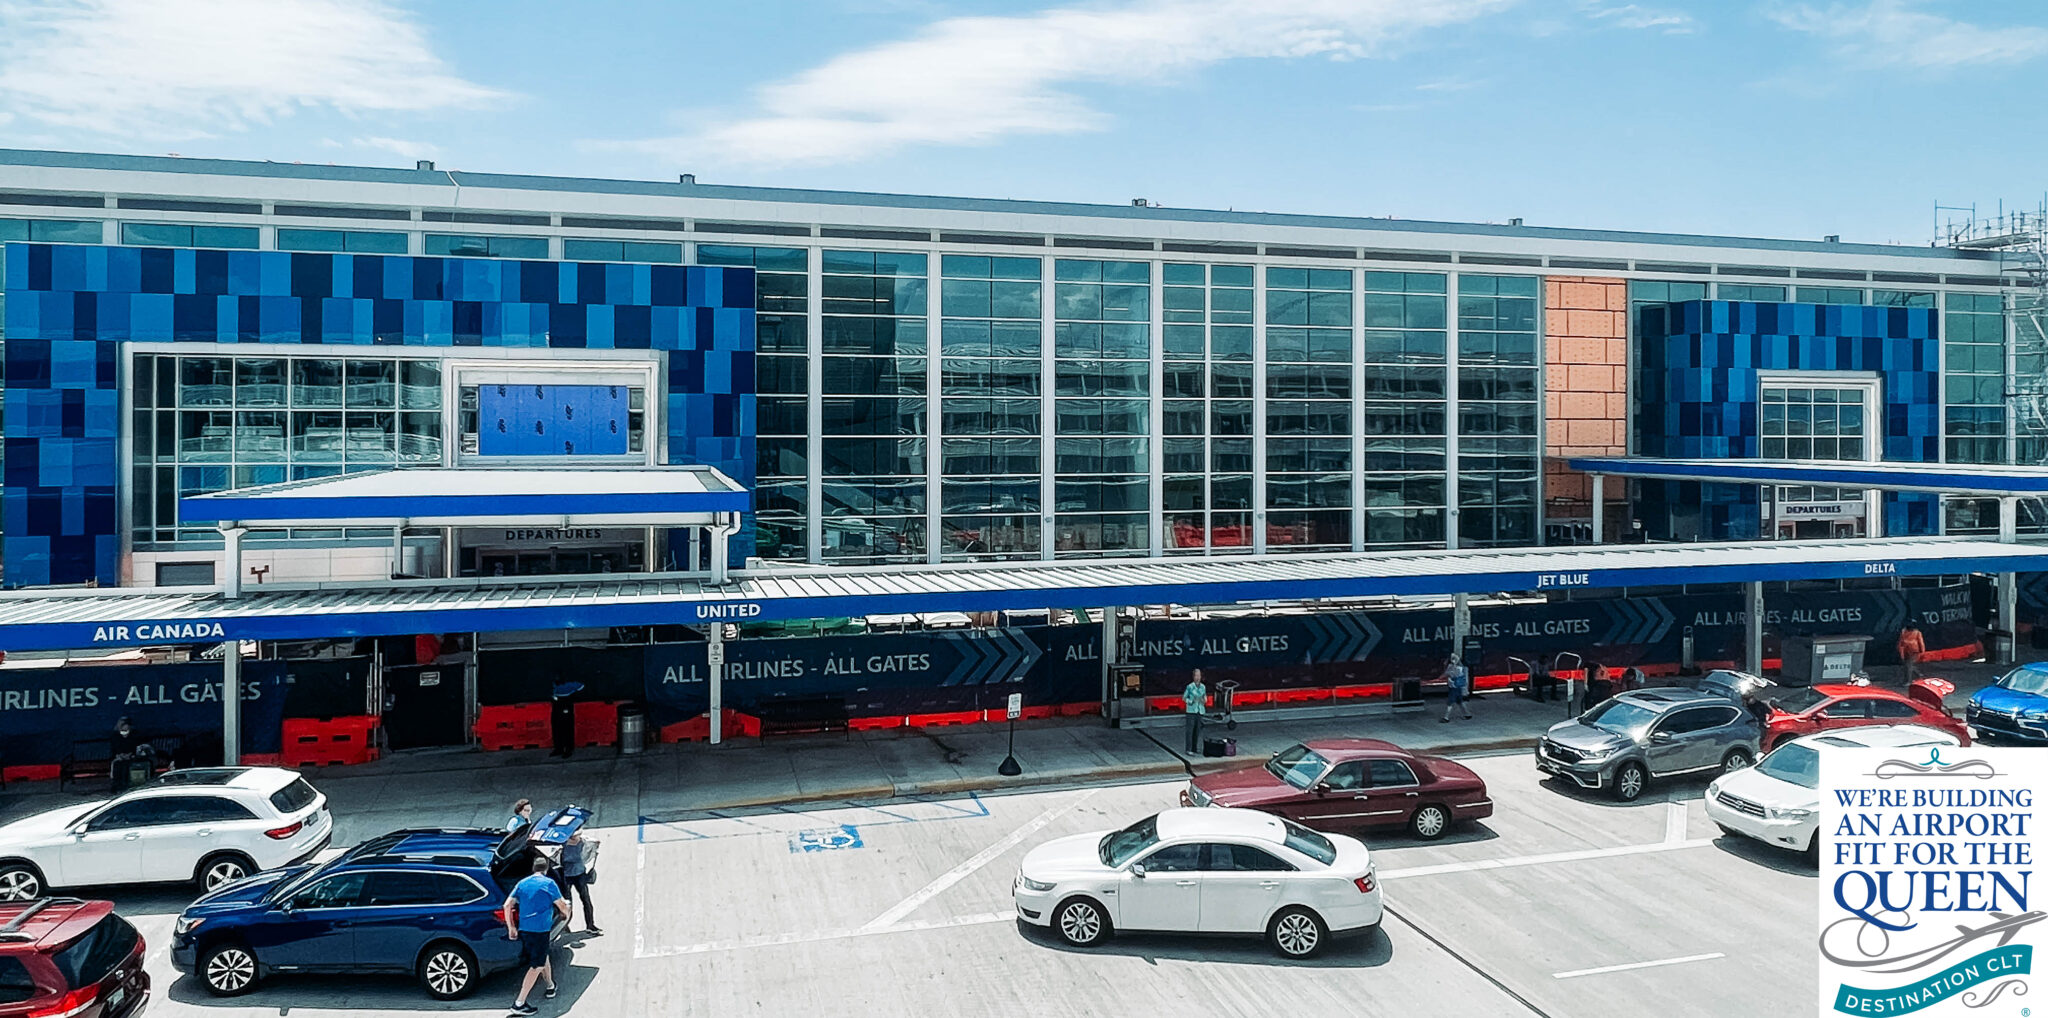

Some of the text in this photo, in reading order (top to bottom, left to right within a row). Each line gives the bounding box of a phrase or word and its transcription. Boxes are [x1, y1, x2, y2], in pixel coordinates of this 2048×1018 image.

[1786, 505, 1841, 514] DEPARTURES
[505, 529, 601, 540] DEPARTURES
[1865, 563, 1895, 574] DELTA
[1537, 573, 1589, 588] JET BLUE
[696, 604, 761, 619] UNITED
[1694, 611, 1721, 626] ALL
[1791, 609, 1816, 623] ALL
[1818, 608, 1862, 622] GATES
[1922, 611, 1939, 624] TO
[93, 622, 225, 641] AIR CANADA
[1402, 627, 1430, 643] ALL
[1514, 622, 1541, 637] ALL
[1544, 619, 1590, 635] GATES
[1065, 644, 1098, 661] ALL
[1201, 638, 1231, 655] ALL
[1236, 635, 1289, 653] GATES
[662, 664, 703, 684] ALL
[720, 660, 804, 682] IRLINES
[824, 657, 861, 675] ALL
[867, 653, 930, 673] GATES
[124, 684, 173, 705] ALL
